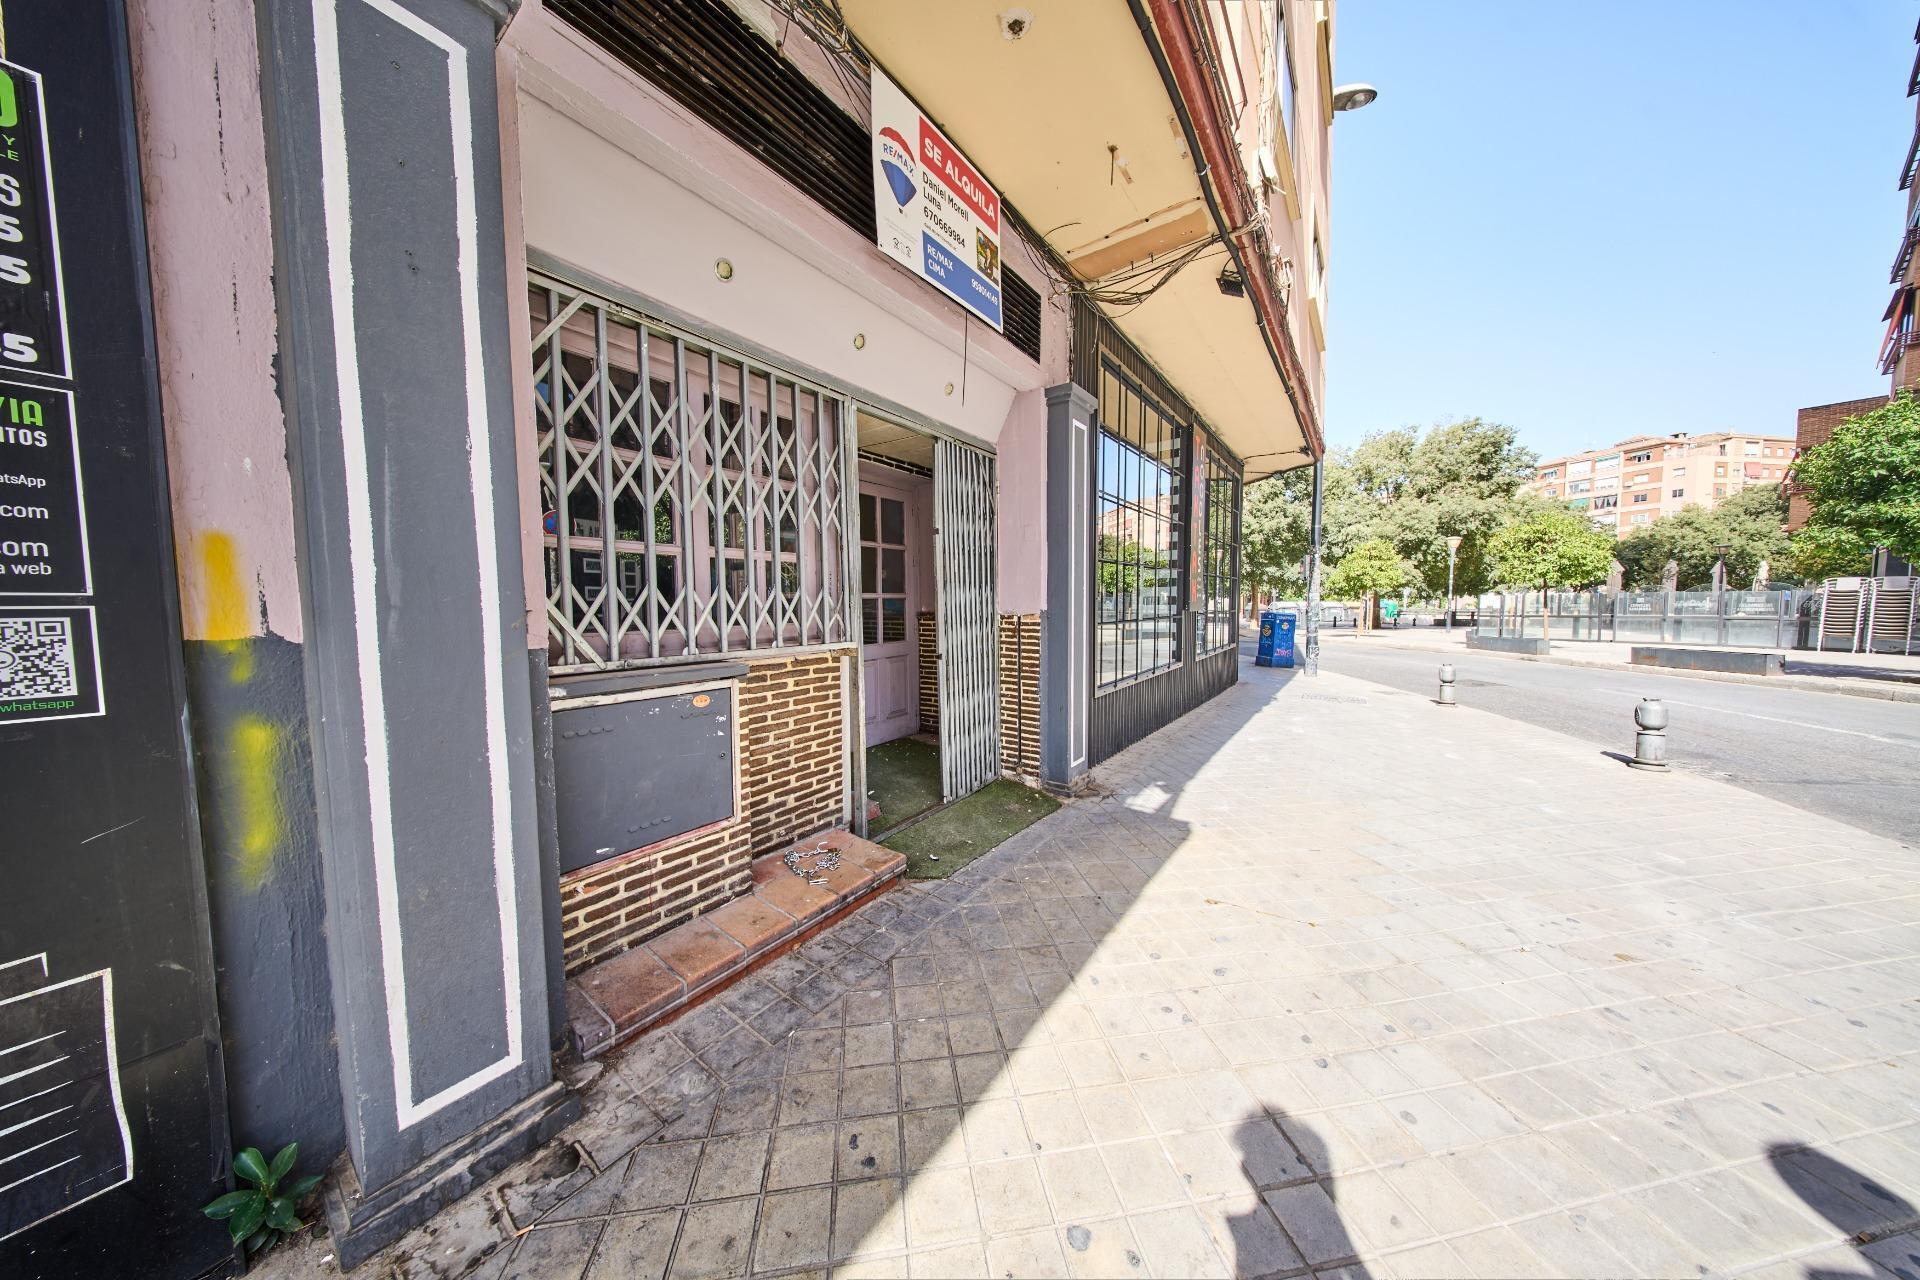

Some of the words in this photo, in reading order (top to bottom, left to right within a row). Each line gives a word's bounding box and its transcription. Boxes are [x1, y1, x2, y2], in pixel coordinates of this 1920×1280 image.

[883, 142, 914, 176] RE/MAX
[924, 137, 943, 169] SE
[945, 159, 996, 222] ALQUILA
[922, 170, 946, 202] Daniel
[947, 193, 969, 222] Morell
[923, 186, 942, 211] Luna
[923, 206, 966, 248] 670669984
[927, 244, 954, 271] RE/MAX
[928, 259, 946, 279] CIMA
[0, 332, 38, 363] S
[0, 541, 49, 557] om
[11, 561, 52, 575] web
[0, 700, 75, 712] whatsapp
